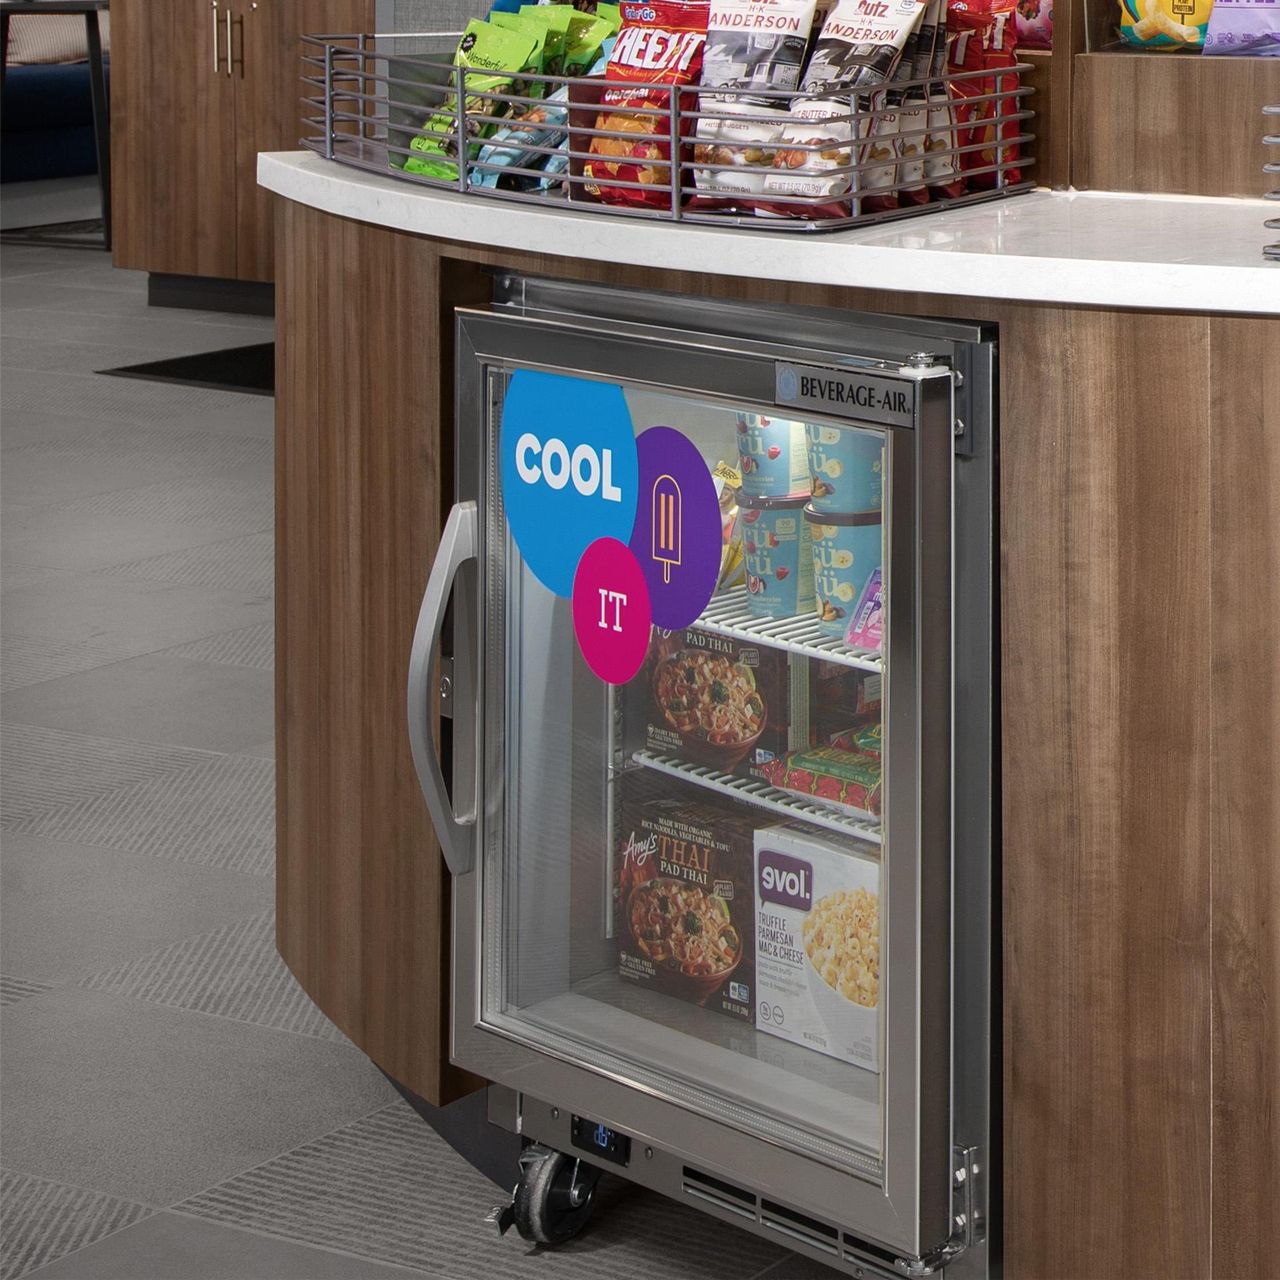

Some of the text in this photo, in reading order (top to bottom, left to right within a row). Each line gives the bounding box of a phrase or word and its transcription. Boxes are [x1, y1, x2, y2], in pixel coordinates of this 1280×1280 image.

[709, 12, 801, 31] ANDERSON
[822, 22, 899, 41] ANDERSON
[801, 376, 907, 414] BEVERAGE-AIR
[515, 433, 621, 502] COOL
[598, 588, 627, 632] IT
[686, 632, 733, 654] PAD THAI
[623, 831, 658, 869] Amy's
[659, 835, 711, 873] THAI
[660, 861, 707, 885] PAD THAI
[759, 912, 786, 930] TRUFFLE
[758, 926, 794, 946] PARMESAN
[759, 941, 804, 965] MAC & CHEESE
